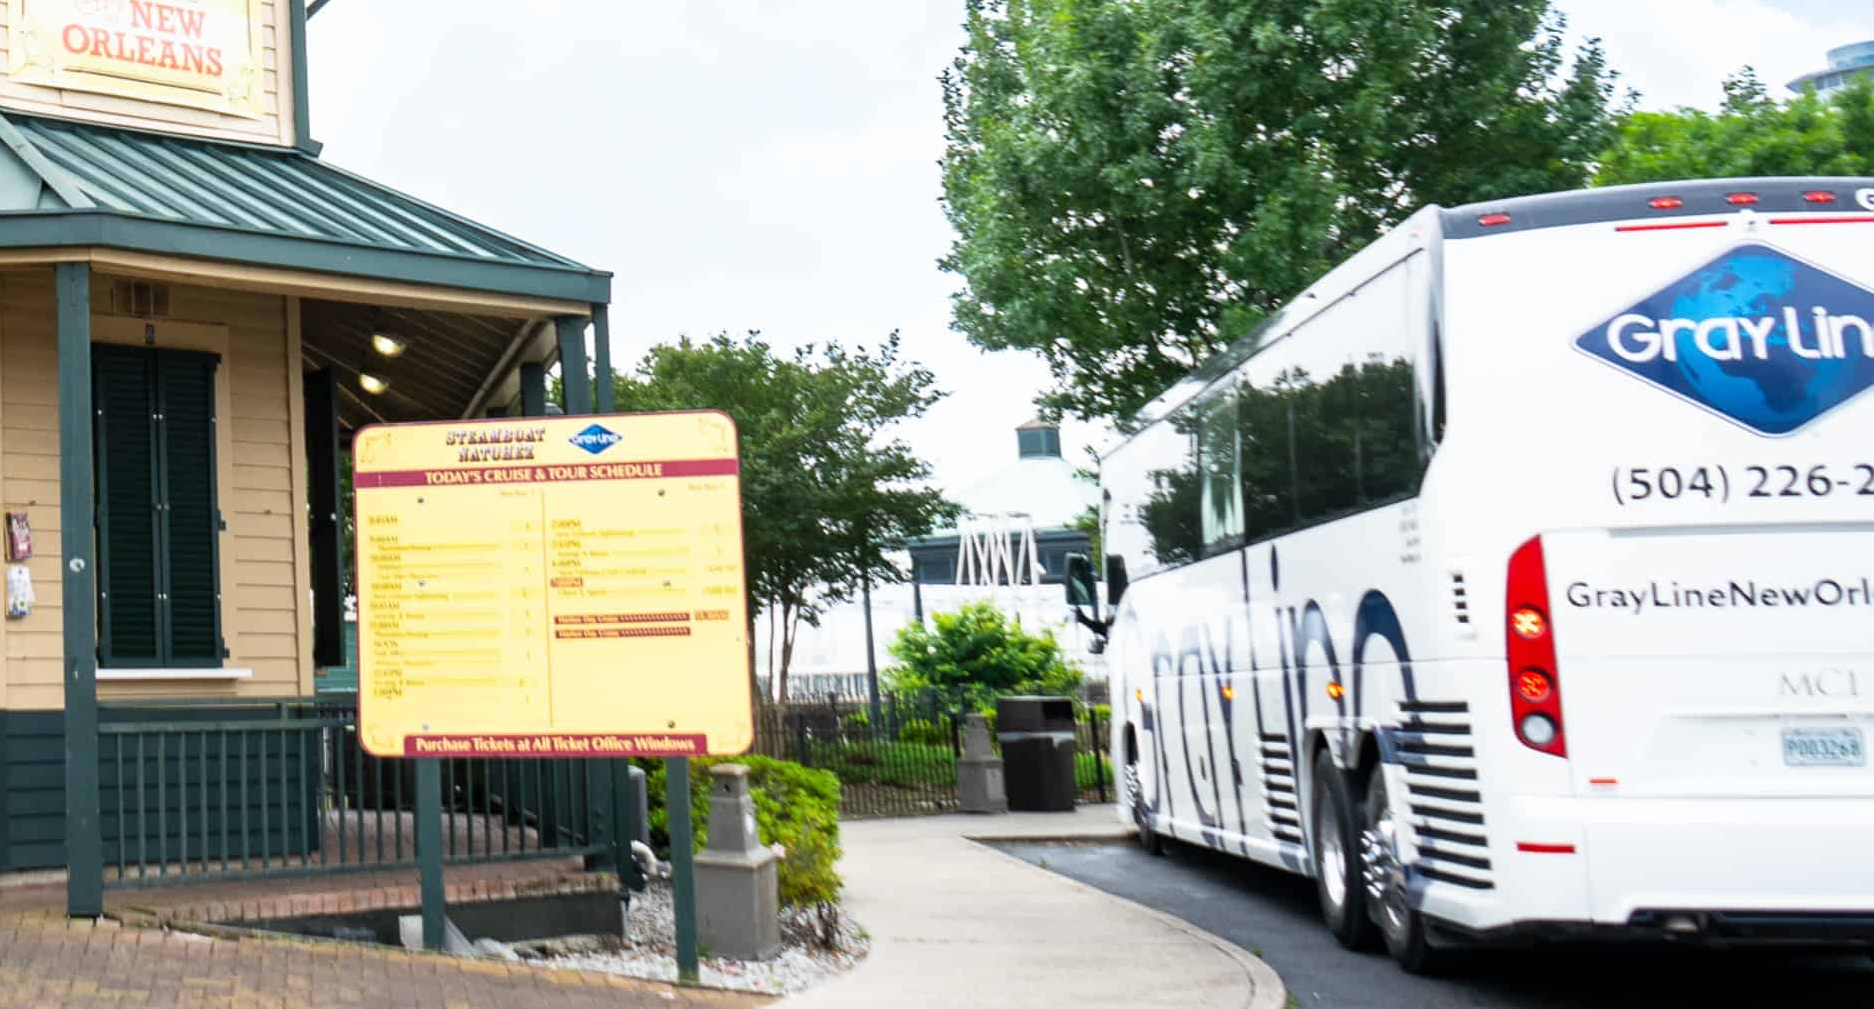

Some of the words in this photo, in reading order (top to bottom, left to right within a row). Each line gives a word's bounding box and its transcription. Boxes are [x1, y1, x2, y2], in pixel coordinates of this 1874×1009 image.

[129, 0, 207, 39] NEW
[62, 24, 223, 78] ORLEANS
[1781, 305, 1874, 360] Lin
[446, 428, 546, 445] STEAMBOAT
[458, 446, 535, 462] NATCHEZ
[425, 470, 481, 485] TODAY'S
[484, 468, 532, 482] CRUISE
[534, 468, 547, 480] &
[549, 466, 587, 480] TOUR
[589, 463, 663, 479] SCHEDULE
[1612, 464, 1730, 505] (504)
[1566, 577, 1874, 615] GrayLineNewOrl
[1779, 670, 1859, 698] MCI
[416, 738, 470, 752] Purchase
[472, 737, 515, 751] Tickets
[517, 738, 530, 751] at
[532, 737, 551, 751] All
[553, 737, 589, 751] Ticket
[593, 736, 631, 751] Office
[634, 736, 695, 750] Windows
